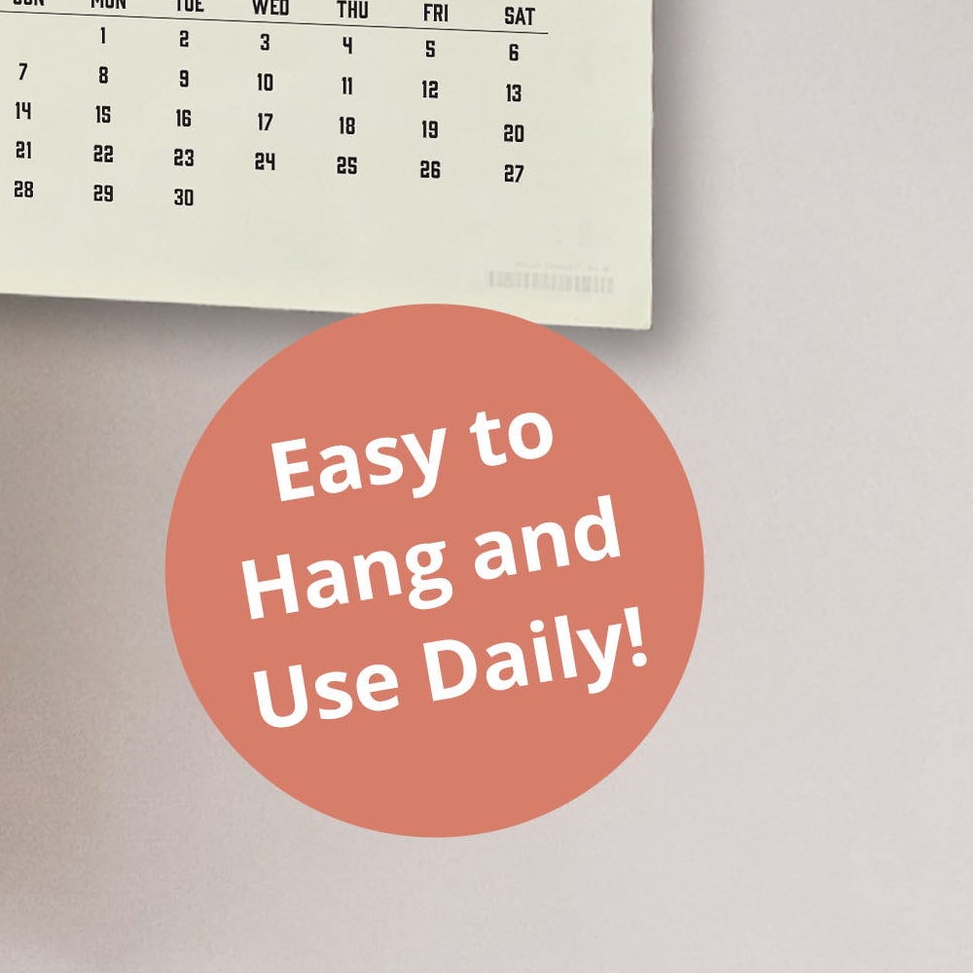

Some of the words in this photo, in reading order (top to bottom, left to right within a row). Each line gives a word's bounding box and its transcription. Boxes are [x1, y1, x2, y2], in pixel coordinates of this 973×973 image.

[336, 0, 369, 19] THU
[423, 3, 449, 22] FRI
[504, 6, 536, 26] SAT
[99, 26, 106, 44] 1
[179, 30, 189, 48] 2
[260, 34, 270, 51] 3
[342, 37, 353, 55] 4
[425, 40, 436, 58] 5
[509, 44, 519, 61] 6
[18, 63, 28, 81] 7
[99, 66, 108, 84] 8
[179, 70, 189, 87] 9
[257, 73, 274, 92] 10
[341, 77, 353, 95] 11
[421, 80, 439, 99] 12
[506, 84, 522, 103] 13
[15, 102, 31, 120] 14
[95, 106, 111, 124] 15
[175, 109, 192, 128] 16
[257, 113, 274, 131] 17
[339, 116, 356, 135] 18
[421, 120, 439, 139] 19
[504, 124, 525, 143] 20
[15, 141, 32, 159] 21
[93, 145, 114, 163] 22
[174, 148, 194, 167] 23
[255, 152, 276, 171] 24
[336, 156, 358, 175] 25
[420, 160, 441, 179] 26
[504, 164, 525, 183] 27
[14, 180, 34, 198] 28
[93, 184, 114, 203] 29
[174, 188, 194, 207] 30
